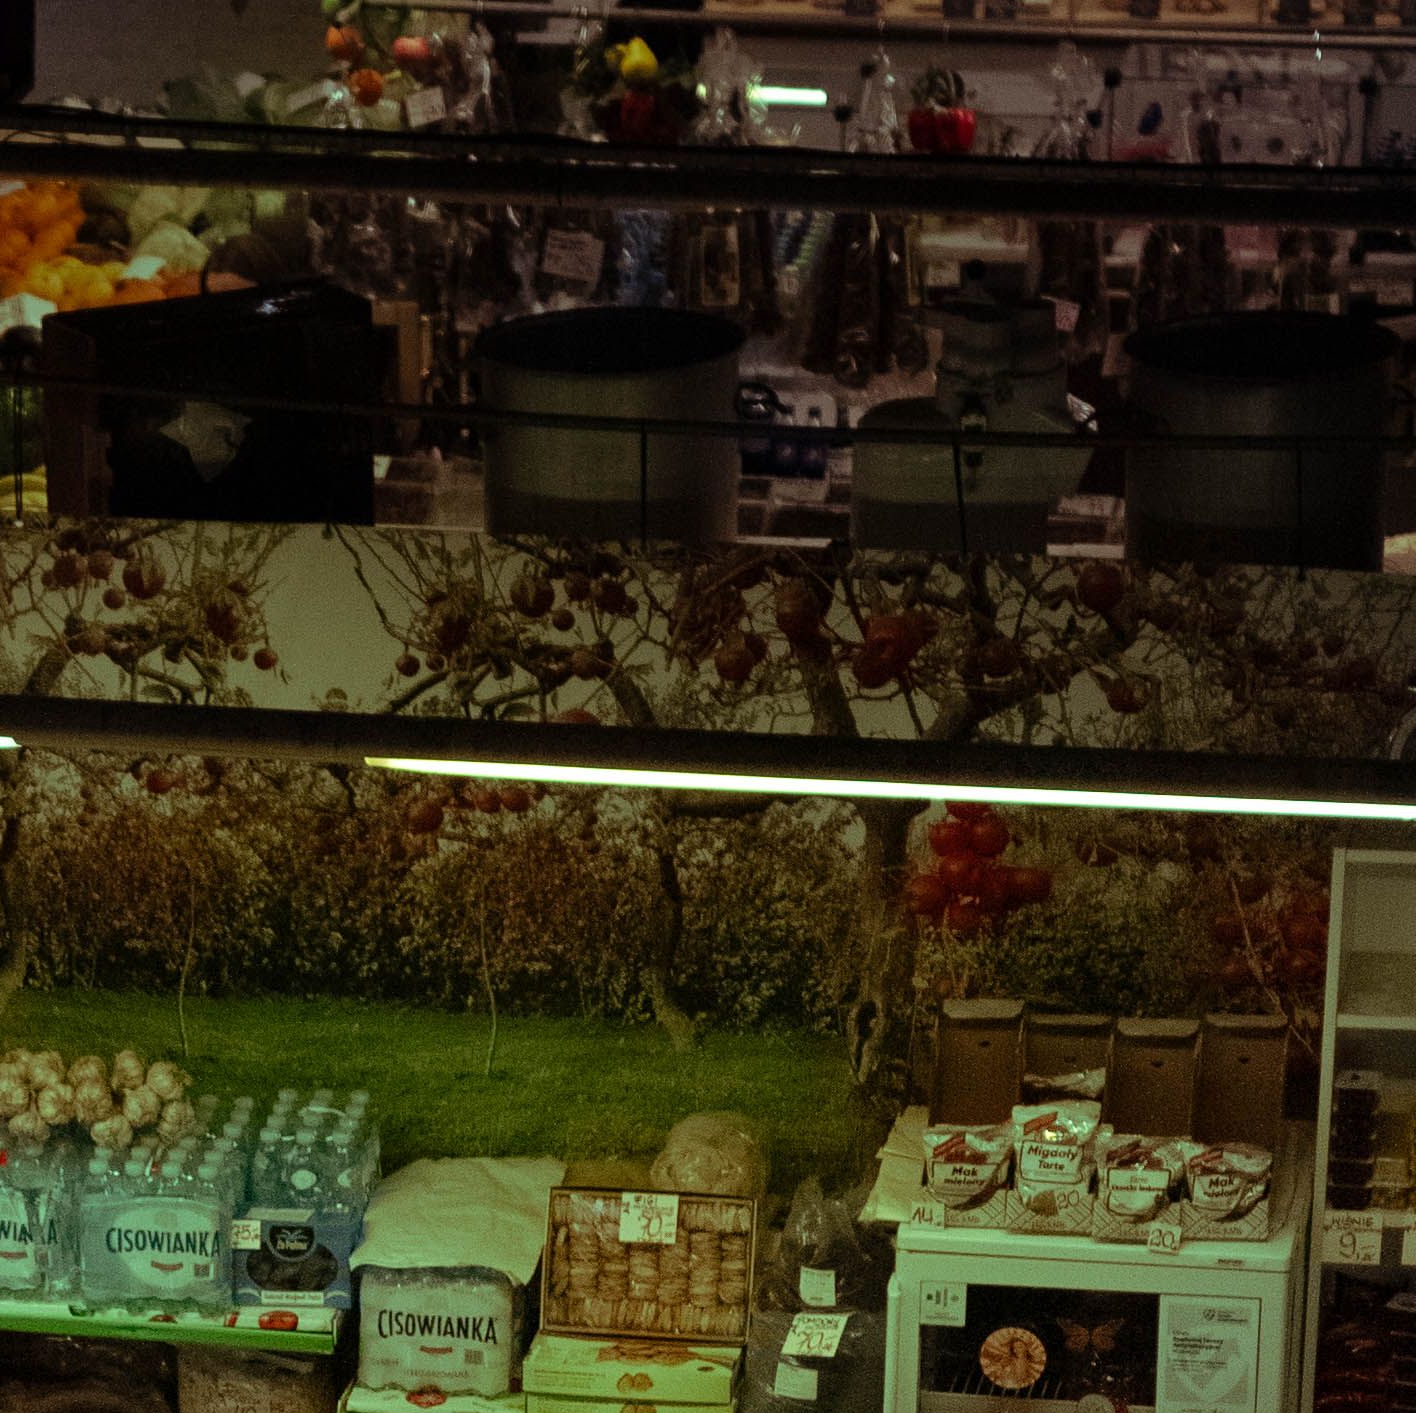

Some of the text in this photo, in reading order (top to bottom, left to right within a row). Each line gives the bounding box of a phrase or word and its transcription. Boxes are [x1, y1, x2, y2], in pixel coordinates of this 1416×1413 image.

[952, 1166, 978, 1177] Mak
[1209, 1177, 1233, 1188] Mak
[106, 1228, 221, 1257] CISOWIANKA
[377, 1309, 498, 1344] CISOWIANKA
